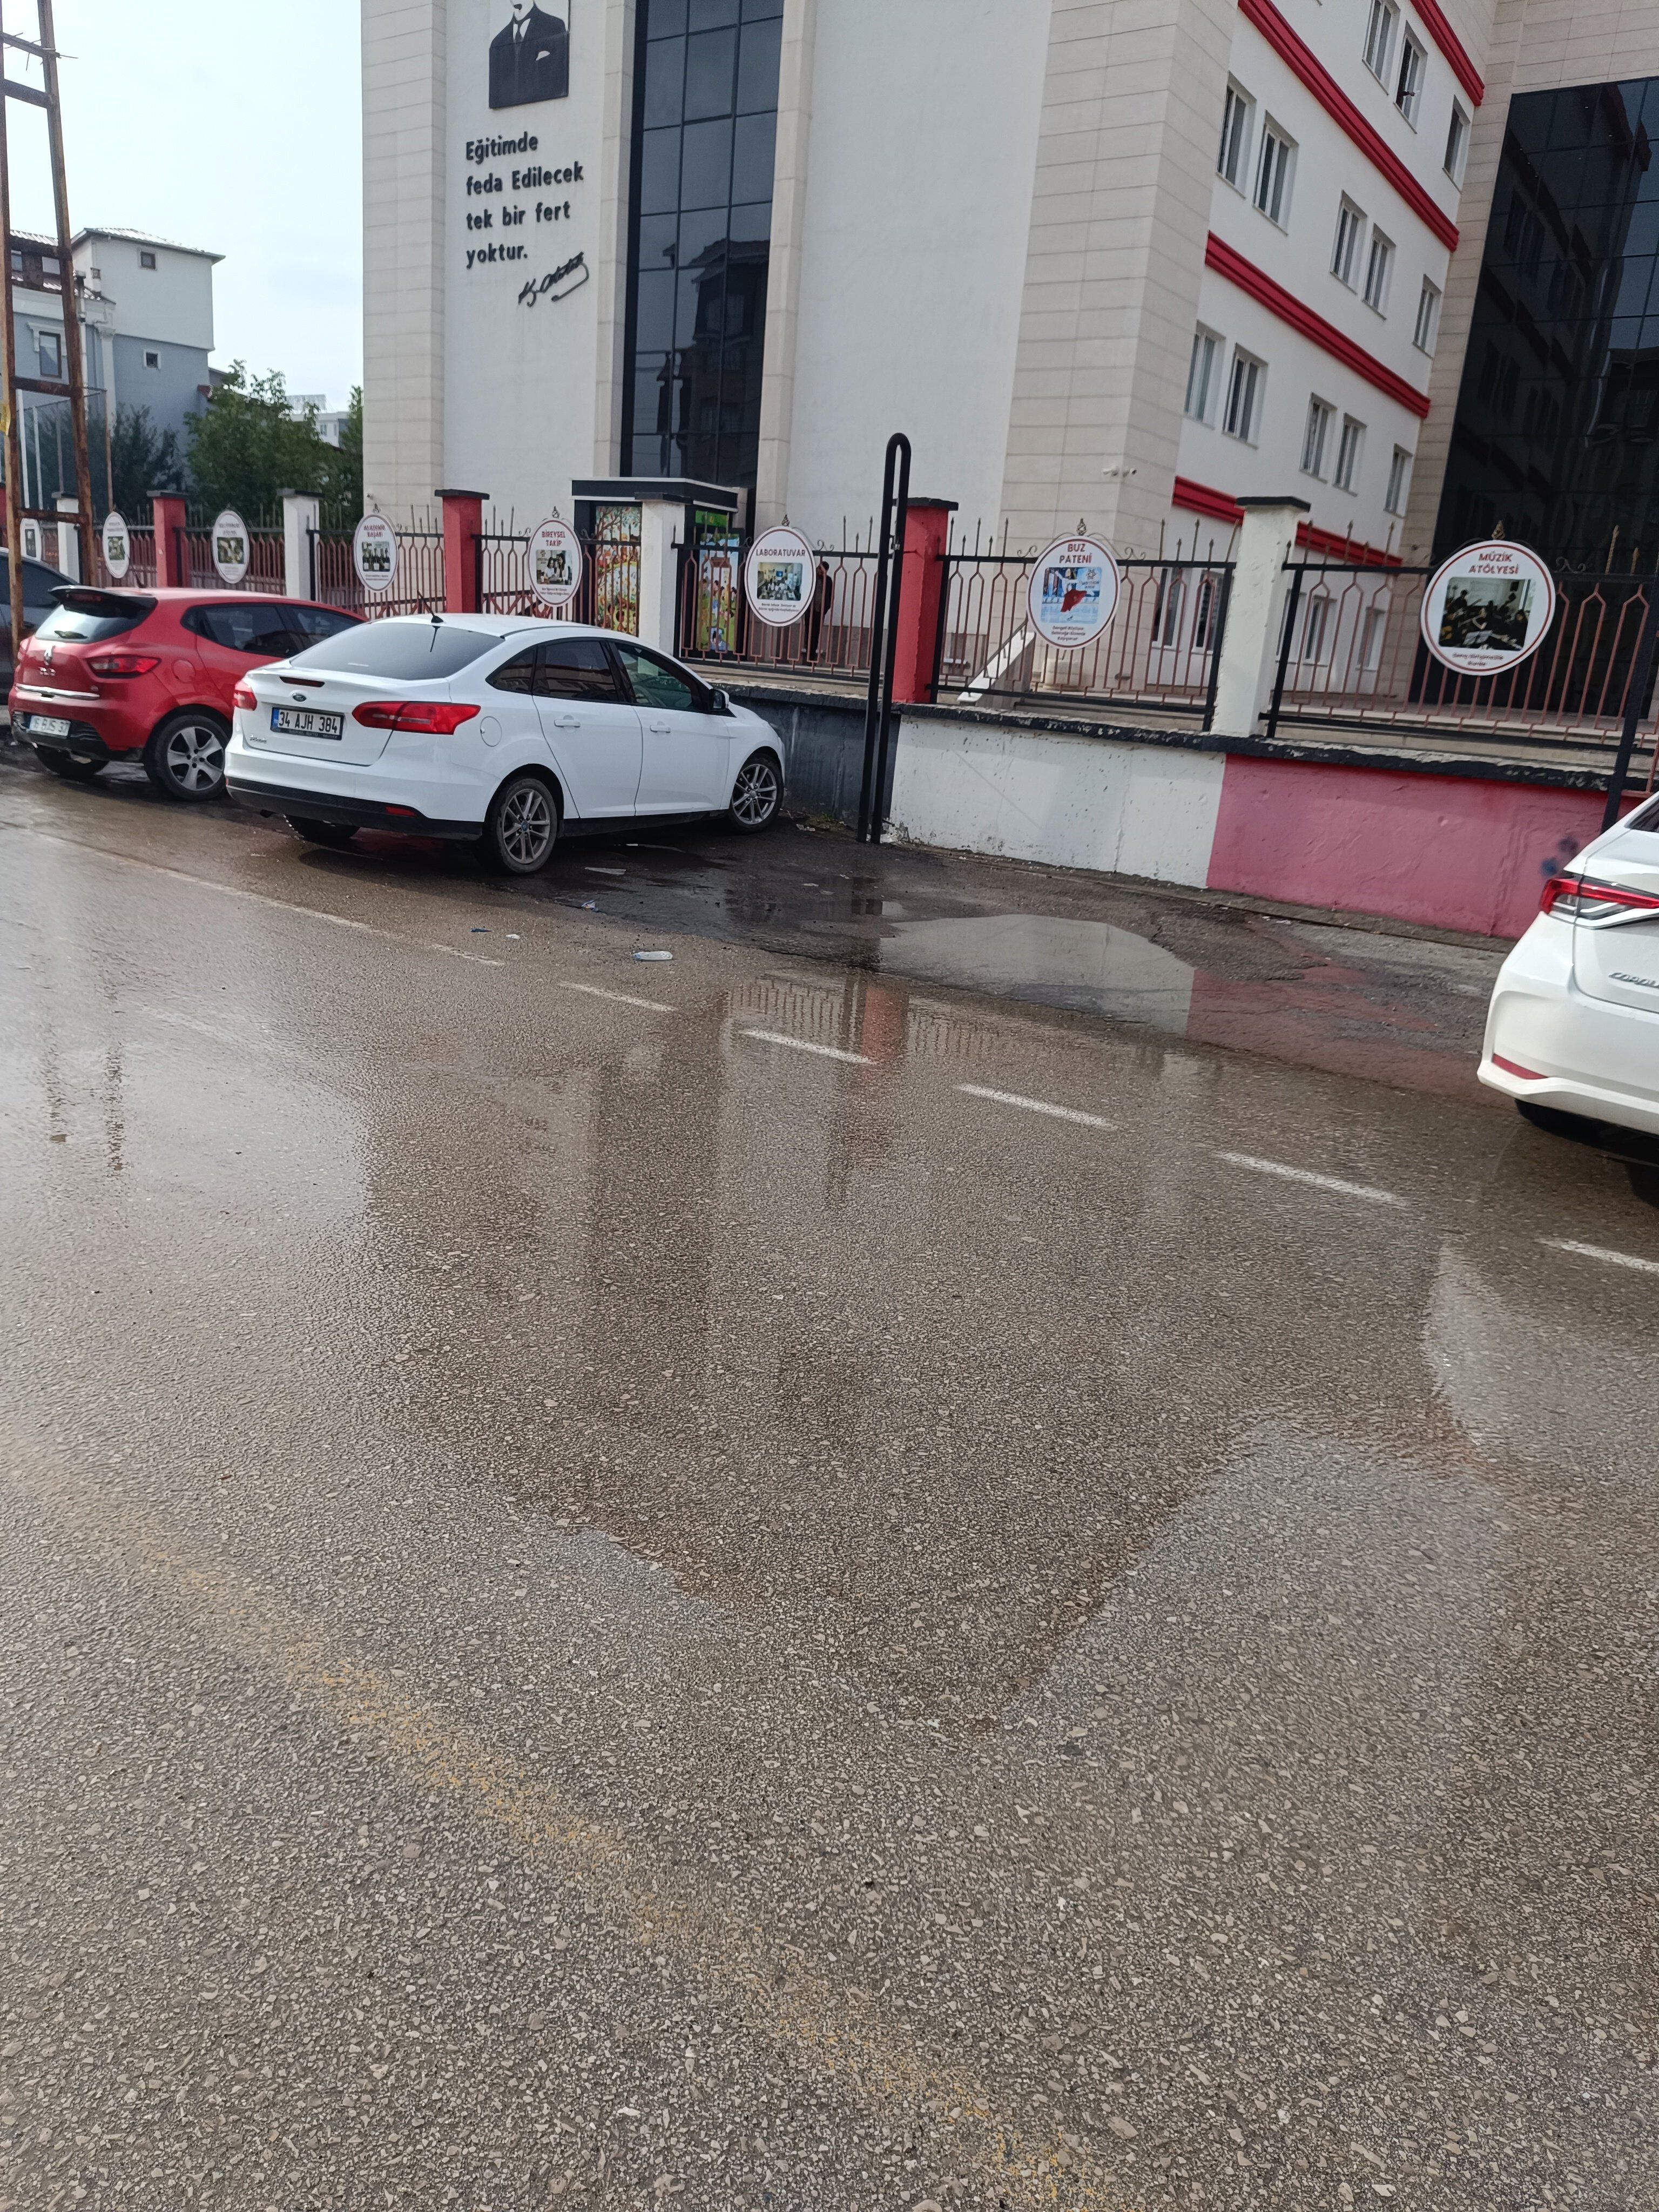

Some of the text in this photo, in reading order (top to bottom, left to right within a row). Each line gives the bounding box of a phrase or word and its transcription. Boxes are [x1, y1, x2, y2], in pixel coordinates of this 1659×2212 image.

[466, 131, 538, 165] Eğitimde
[467, 161, 584, 195] feda Edilecek
[467, 201, 570, 230] tek bir fert
[467, 242, 528, 269] yoktur.
[756, 549, 806, 557] LABORATUVAR
[1067, 543, 1085, 552] BUZ
[1059, 552, 1092, 564] PATENİ
[1478, 551, 1514, 563] MÜZİK
[1468, 563, 1520, 575] ATÖLYESİ
[279, 711, 338, 733] 34 AJH 384
[1608, 972, 1659, 989] COROL
